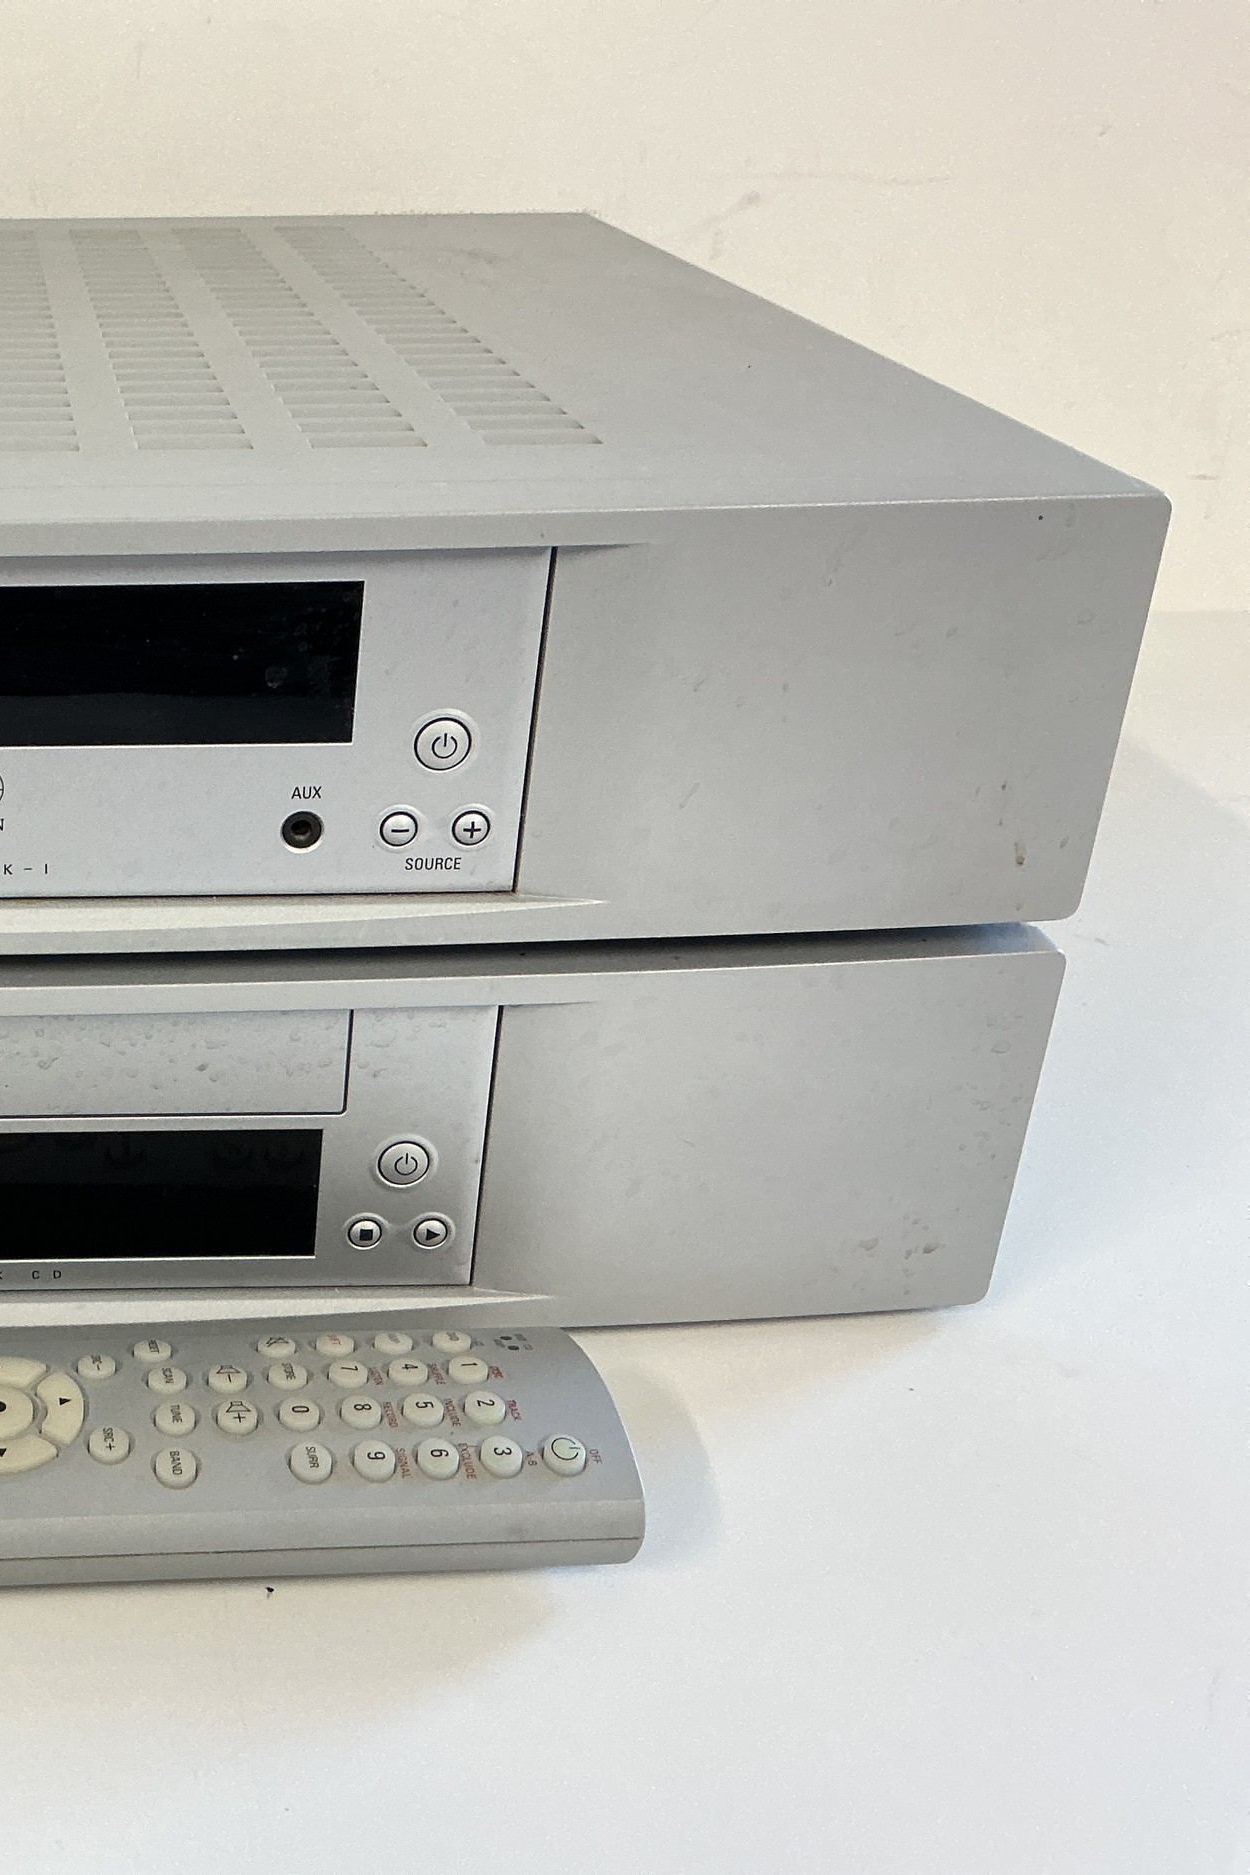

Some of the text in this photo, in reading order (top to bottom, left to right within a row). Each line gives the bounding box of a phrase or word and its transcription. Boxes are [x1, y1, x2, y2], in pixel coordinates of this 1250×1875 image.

[291, 786, 322, 799] AUX
[405, 857, 462, 870] SOURCE
[31, 1270, 62, 1280] CD
[401, 1363, 419, 1371] 4
[162, 1367, 173, 1384] SCAN
[353, 1403, 372, 1411] 8
[415, 1401, 434, 1409] 5
[476, 1399, 495, 1408] 2
[506, 1399, 522, 1421] TRACK
[170, 1404, 182, 1424] TUNE
[367, 1451, 386, 1461] 9
[430, 1448, 449, 1458] 6
[493, 1447, 512, 1456] 3
[589, 1449, 602, 1465] OFF
[169, 1451, 182, 1476] BAND
[396, 1447, 412, 1478] SIGNAL
[458, 1442, 477, 1480] EXCLUDE
